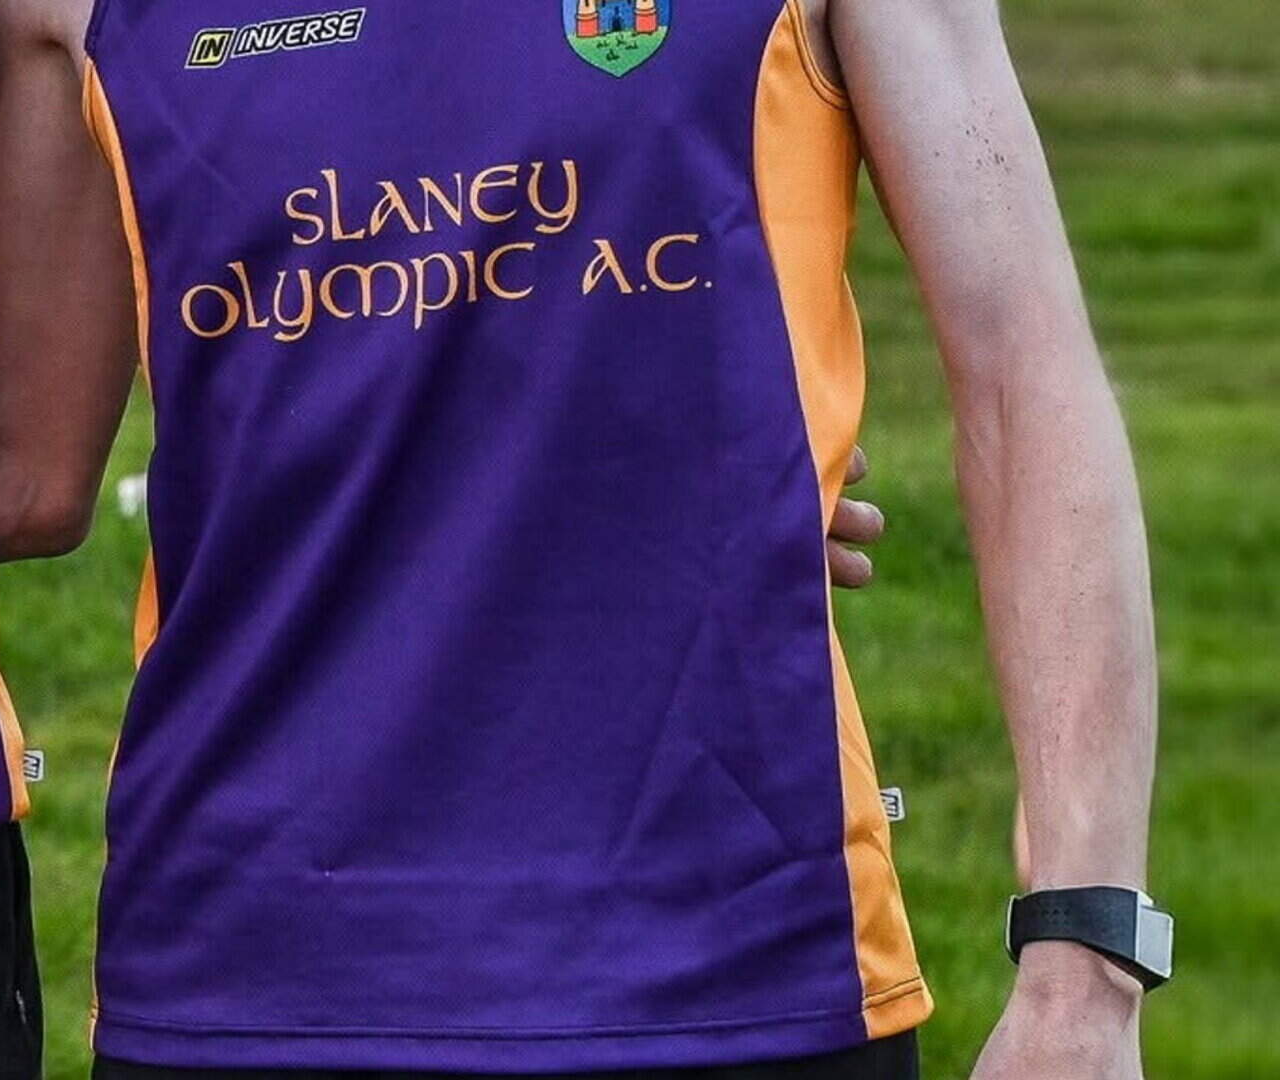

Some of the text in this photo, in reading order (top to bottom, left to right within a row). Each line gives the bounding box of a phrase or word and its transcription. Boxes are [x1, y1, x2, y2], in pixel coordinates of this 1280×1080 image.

[238, 13, 359, 52] INVERSE
[284, 159, 579, 245] SLANEY
[180, 234, 712, 342] OLYMPIC A.C.
